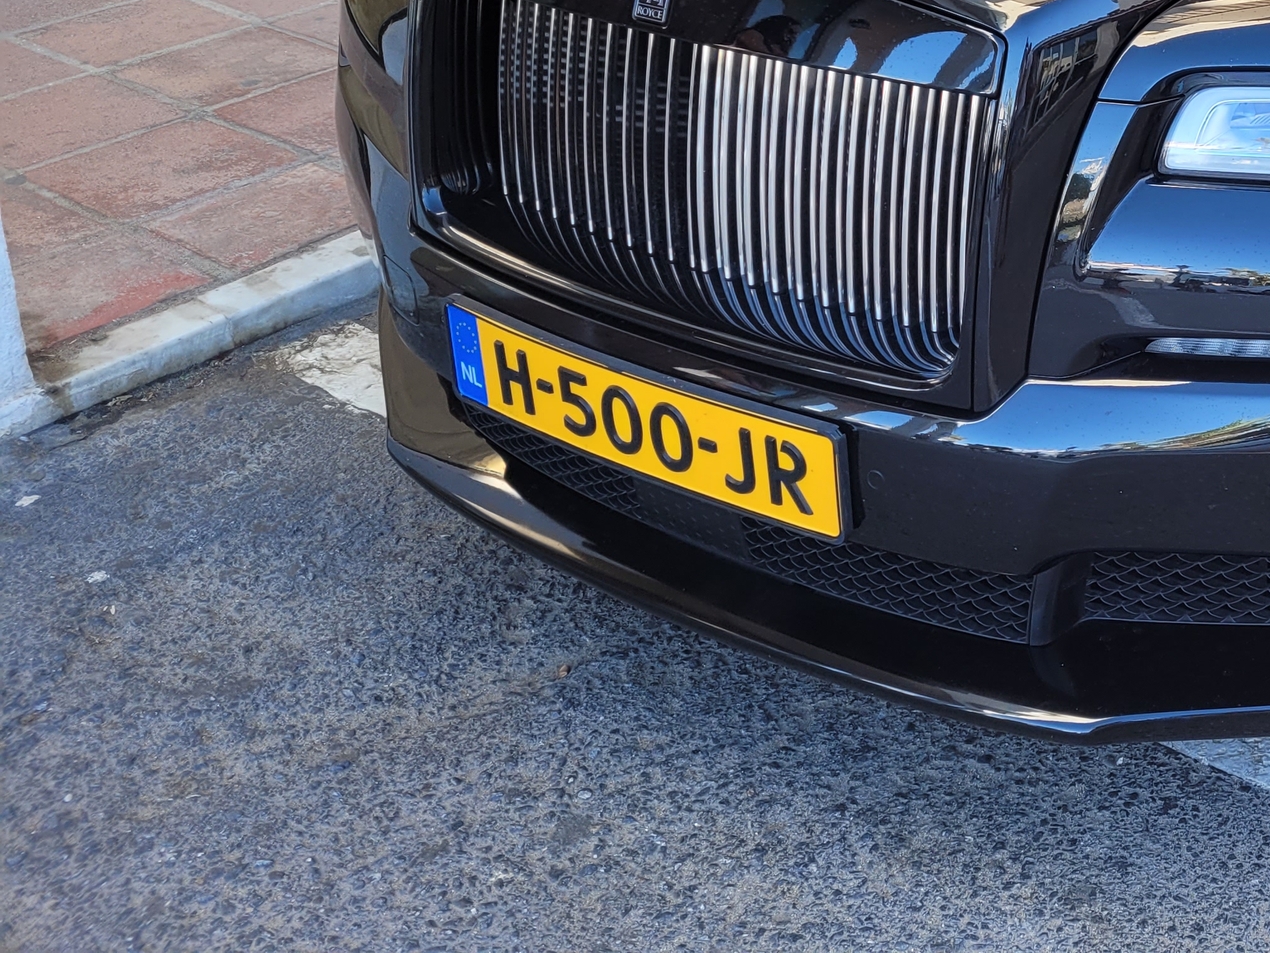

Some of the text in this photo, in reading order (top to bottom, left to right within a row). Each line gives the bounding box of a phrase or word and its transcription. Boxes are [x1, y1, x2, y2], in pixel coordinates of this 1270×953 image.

[637, 5, 663, 19] ROYCE
[460, 361, 483, 388] NL
[494, 339, 814, 515] H-500-JR
